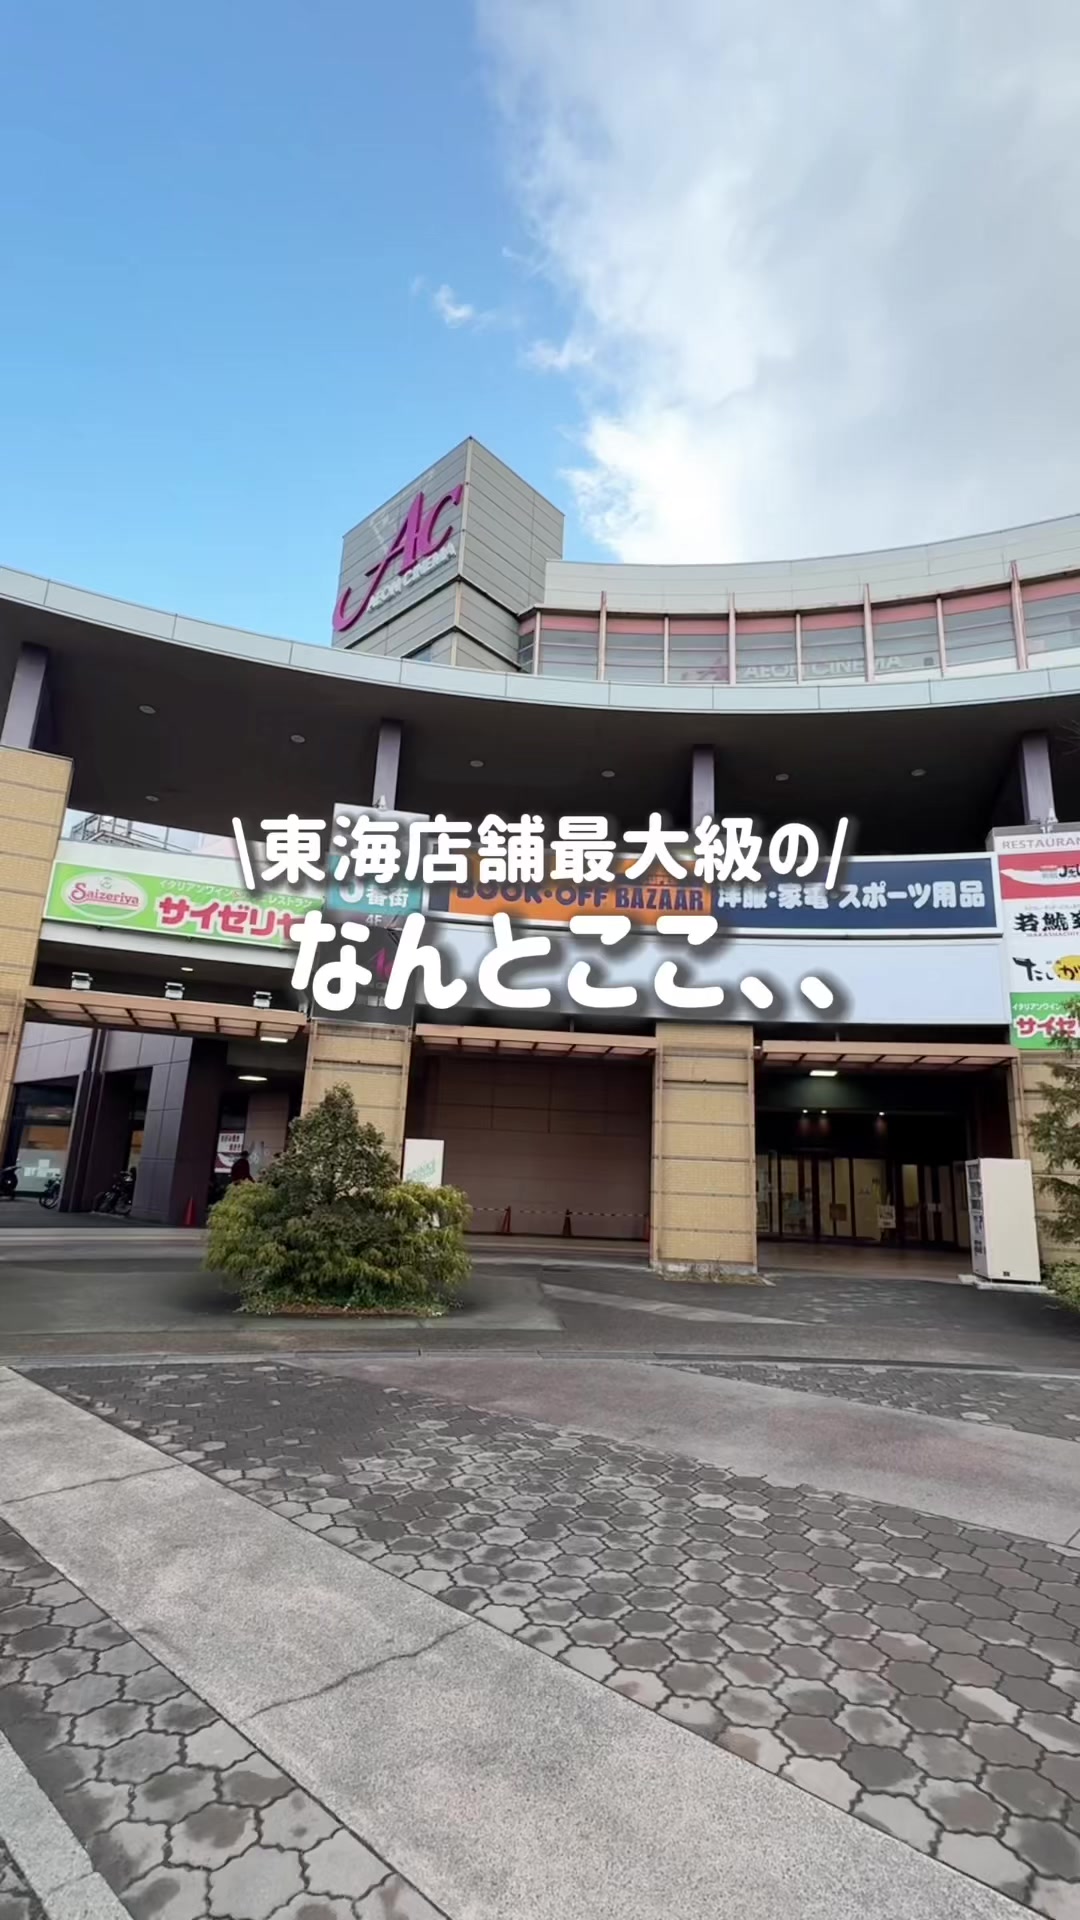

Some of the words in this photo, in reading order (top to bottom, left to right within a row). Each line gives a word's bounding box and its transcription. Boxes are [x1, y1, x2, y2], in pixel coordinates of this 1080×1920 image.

[69, 882, 140, 908] Saizeriya
[615, 887, 704, 912] BAZAAR
[1016, 1016, 1080, 1036] サイゼ
